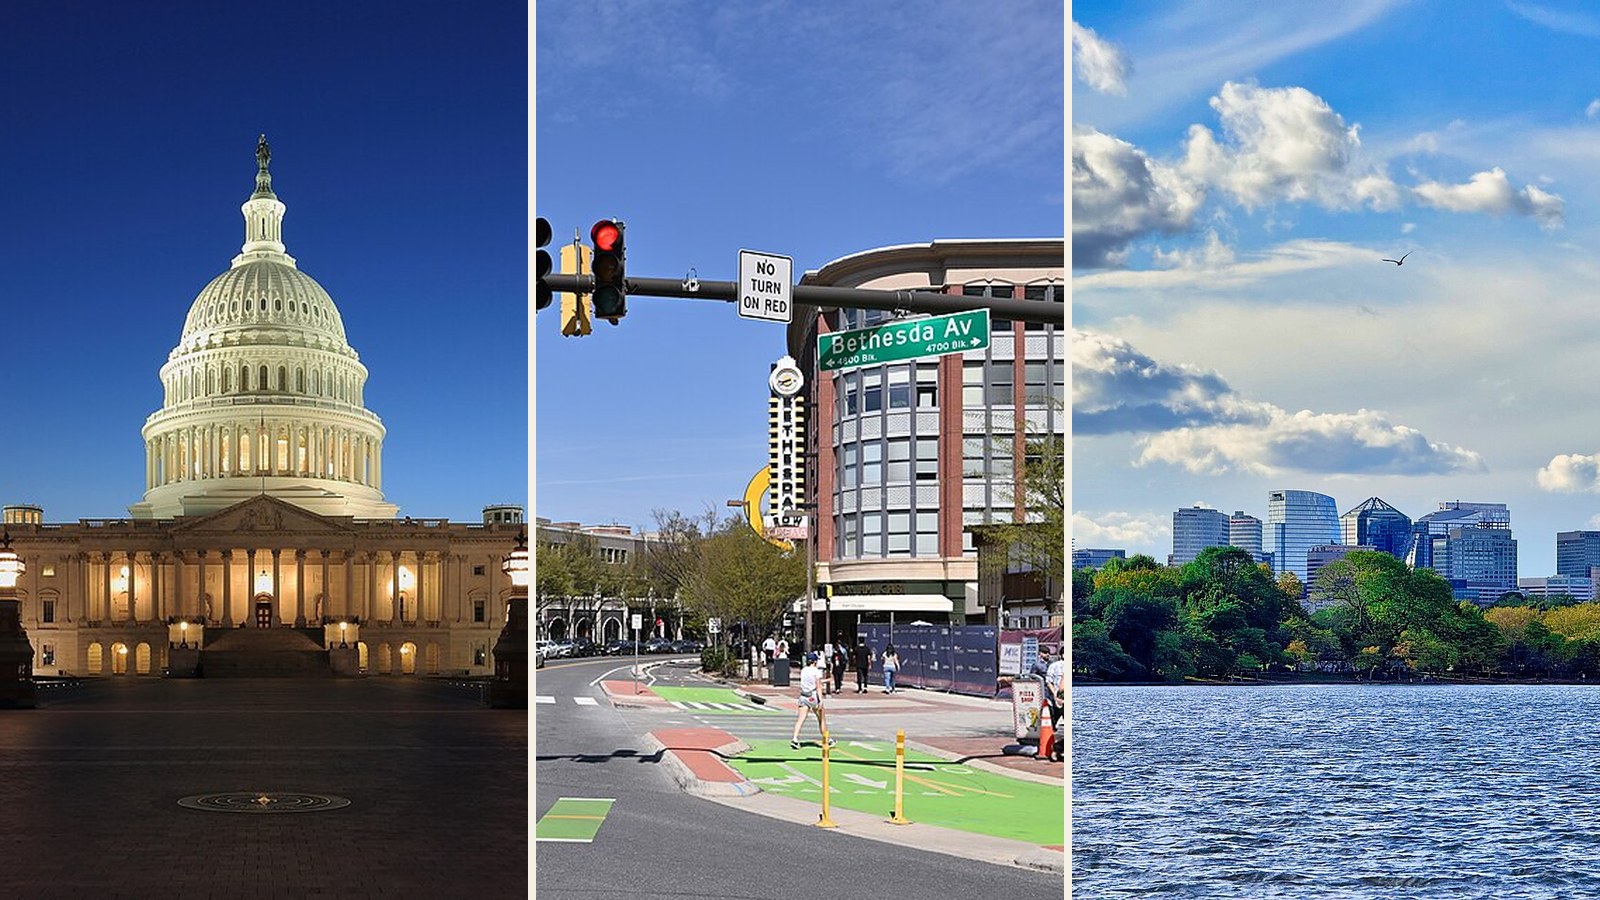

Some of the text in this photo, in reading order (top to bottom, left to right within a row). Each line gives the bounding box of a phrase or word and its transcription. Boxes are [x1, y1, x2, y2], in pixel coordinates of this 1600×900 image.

[756, 261, 775, 276] NO
[751, 278, 781, 295] TURN
[743, 296, 787, 314] ON RED
[831, 318, 973, 355] Bethesda Av
[925, 342, 949, 353] 4700
